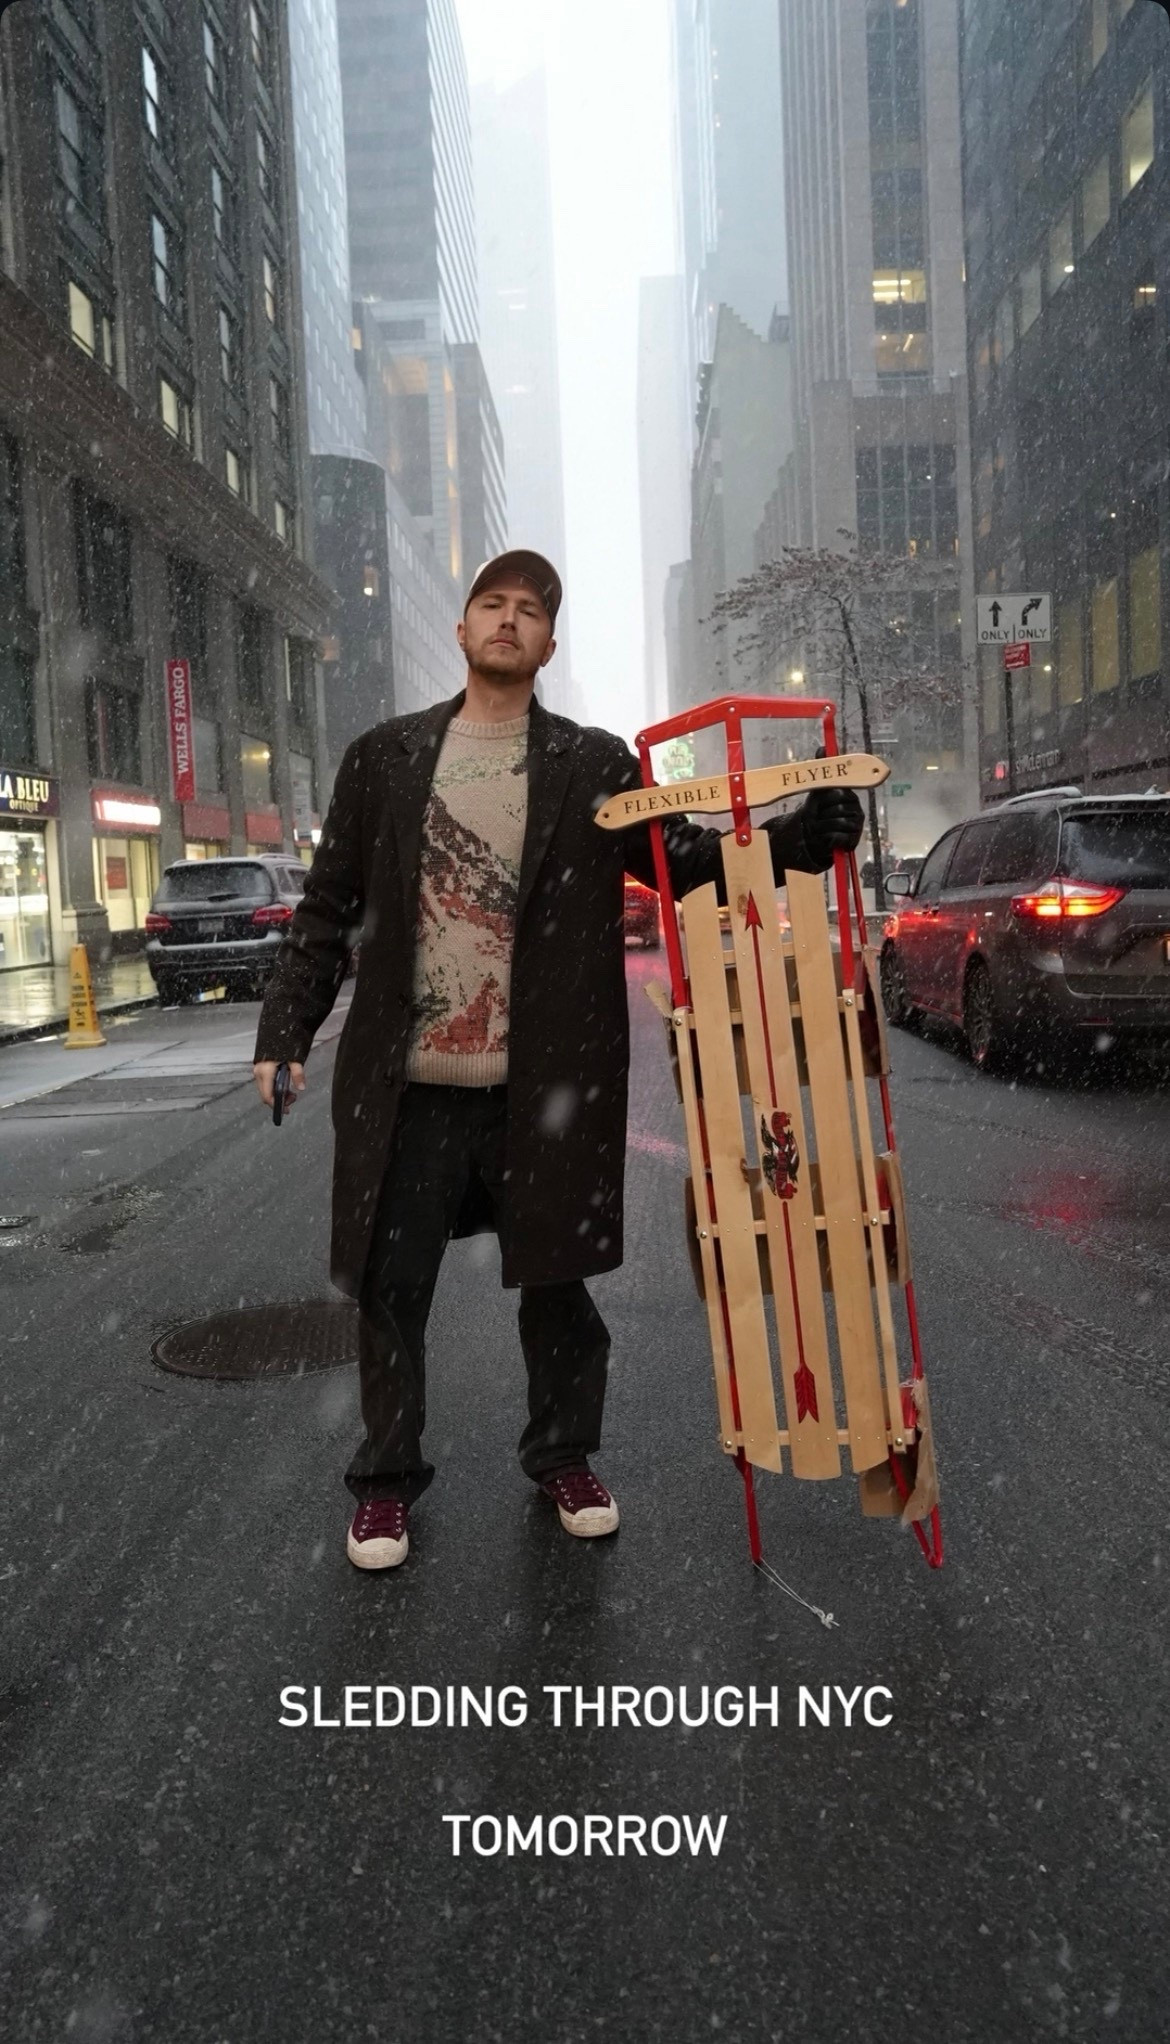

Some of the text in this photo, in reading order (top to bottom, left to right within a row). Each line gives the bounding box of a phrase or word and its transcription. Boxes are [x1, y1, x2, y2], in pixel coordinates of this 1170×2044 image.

[981, 629, 1047, 641] ONLY ONLY
[172, 667, 189, 774] WELLS FARGO
[16, 776, 49, 803] BLEU
[623, 785, 720, 814] FLEXIBLE
